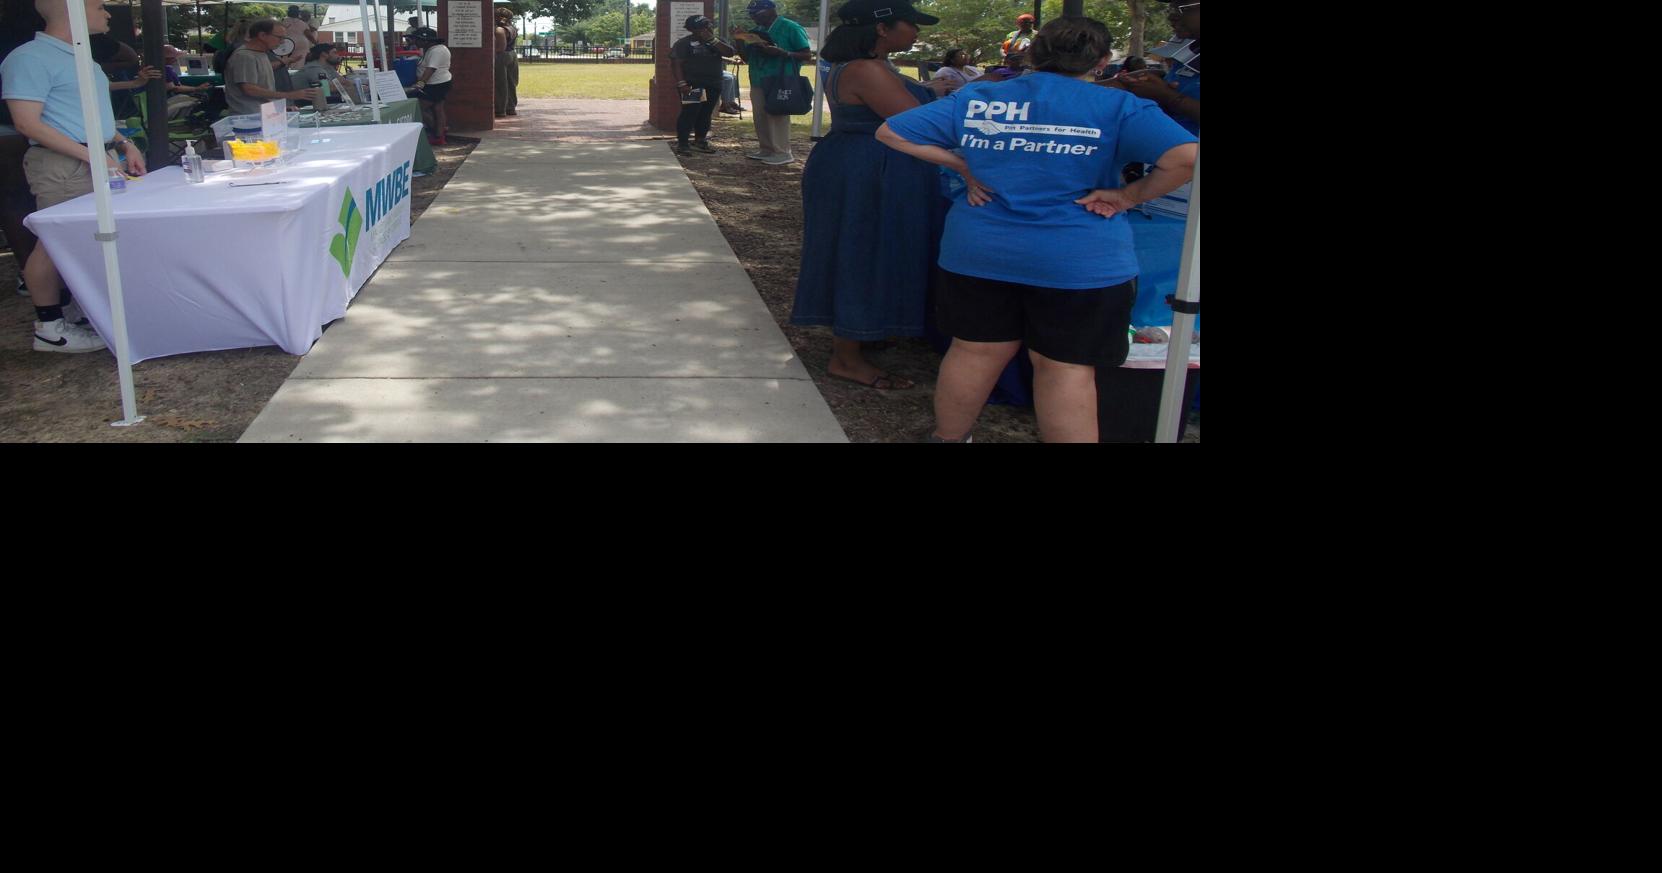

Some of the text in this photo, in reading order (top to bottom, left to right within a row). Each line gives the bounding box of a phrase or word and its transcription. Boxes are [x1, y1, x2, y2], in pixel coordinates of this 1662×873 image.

[966, 100, 1030, 121] PPH
[961, 134, 1098, 156] I'm a Partner
[365, 160, 410, 232] MWBE
